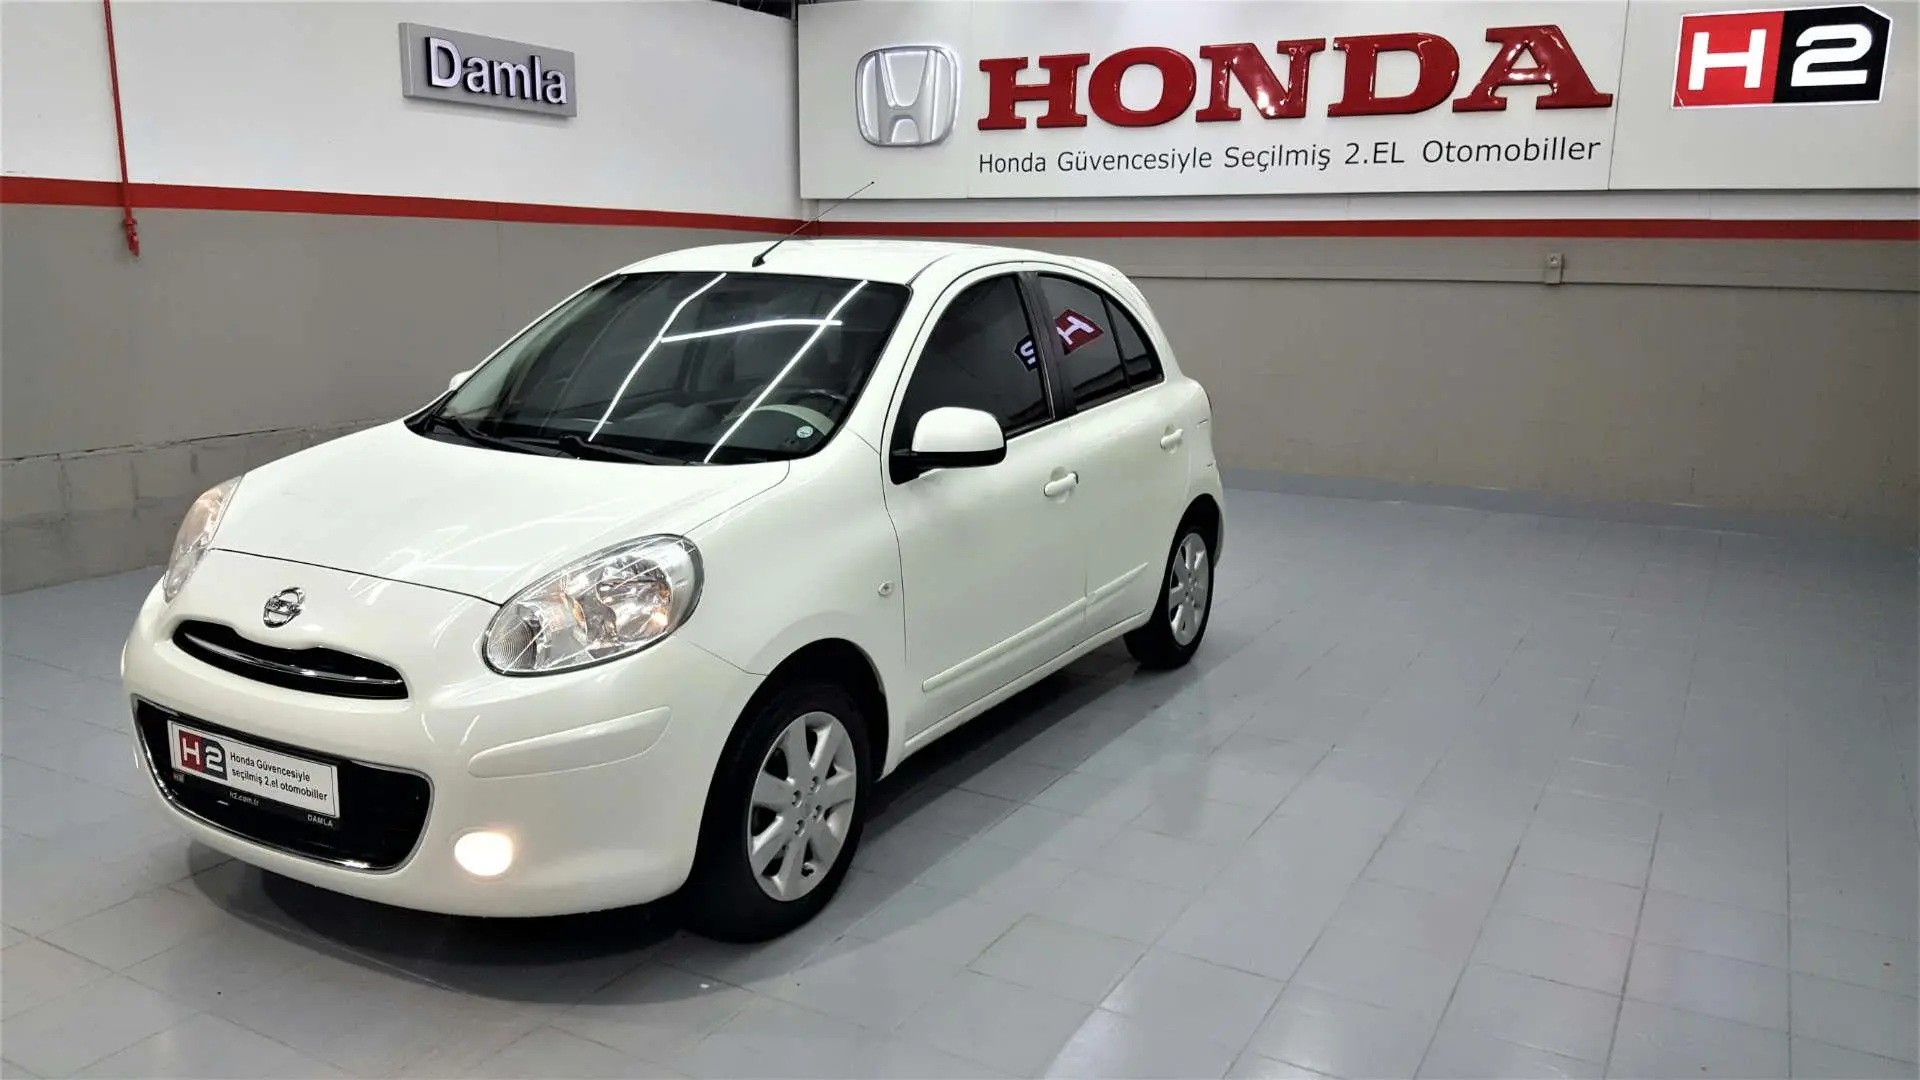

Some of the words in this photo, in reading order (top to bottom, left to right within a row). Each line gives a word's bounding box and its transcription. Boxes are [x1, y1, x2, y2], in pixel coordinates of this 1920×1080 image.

[425, 36, 567, 104] Damla
[1688, 24, 1873, 91] H2
[978, 25, 1613, 130] HONDA
[978, 151, 1047, 174] Honda
[1057, 146, 1213, 174] Güvencesiyle
[1224, 144, 1331, 172] Seçilmiş
[1344, 142, 1405, 165] 2.EL
[1422, 137, 1601, 163] Otomobiller
[182, 736, 224, 773] H2
[230, 751, 255, 767] Honda
[256, 759, 311, 782] Güvencesiyle
[231, 768, 263, 786] seçilmiş
[280, 782, 328, 801] otomobiller
[307, 813, 334, 827] DAMLA
